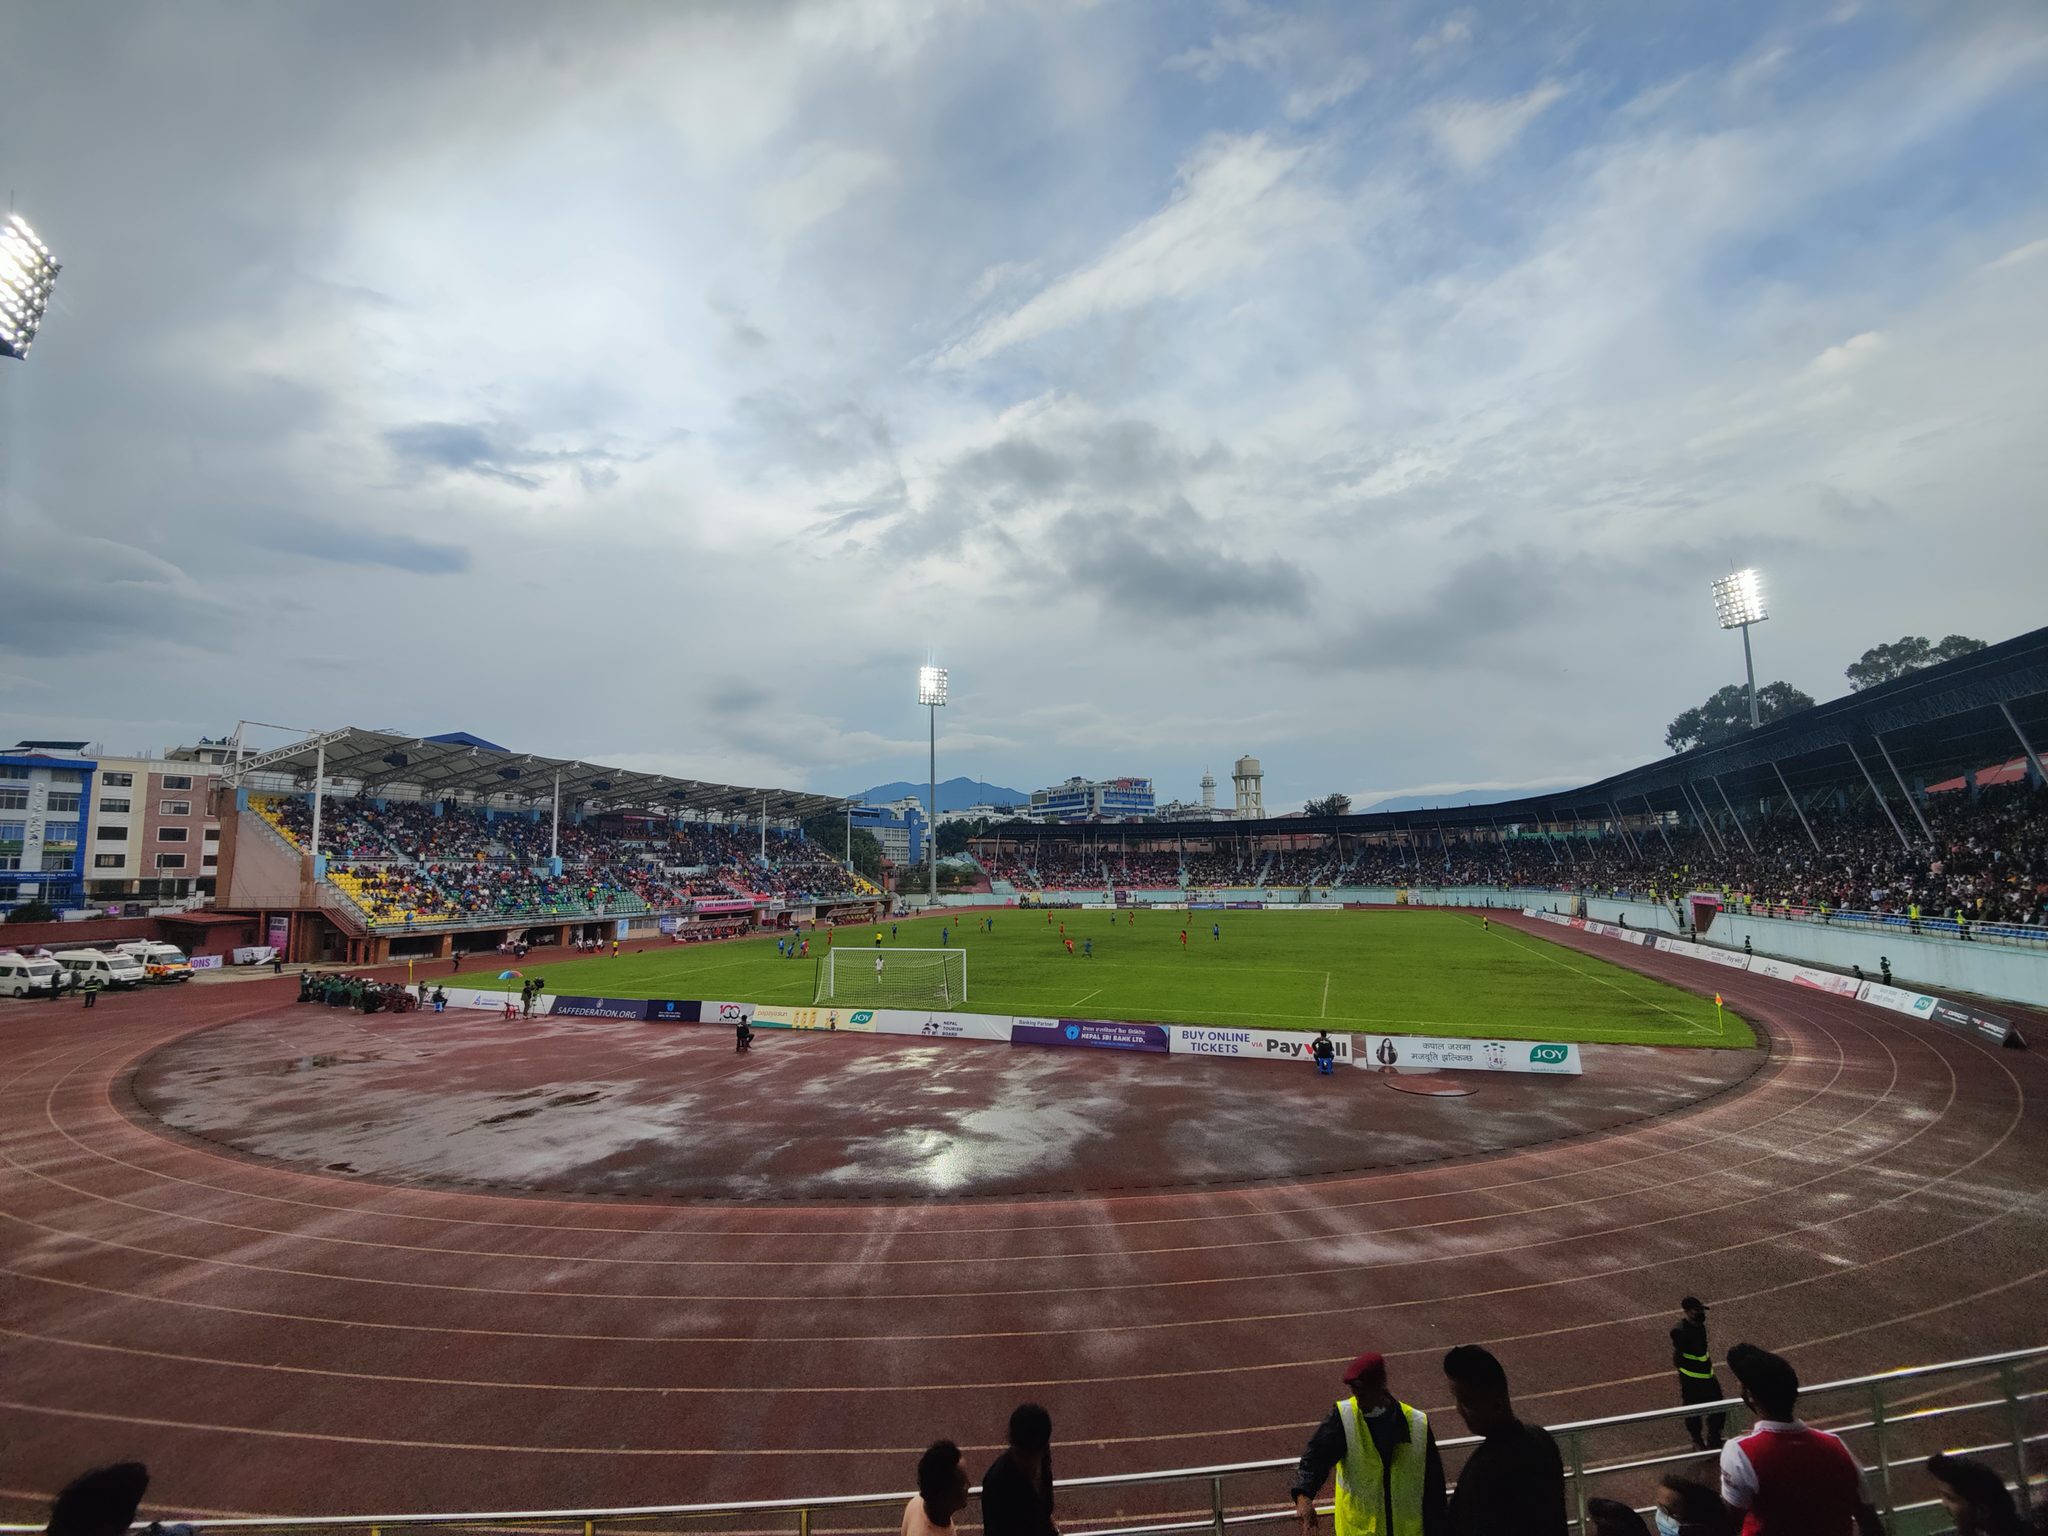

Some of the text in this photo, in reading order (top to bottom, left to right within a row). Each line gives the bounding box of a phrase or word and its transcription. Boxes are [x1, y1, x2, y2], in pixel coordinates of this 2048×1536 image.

[557, 1006, 637, 1019] SAFFEDERATION.ORG
[852, 1014, 871, 1022] JOY
[1018, 1019, 1036, 1027] Banking
[1182, 1030, 1251, 1043] BUY ONLINE
[1190, 1042, 1239, 1054] TICKETS
[1533, 1049, 1565, 1059] JOY
